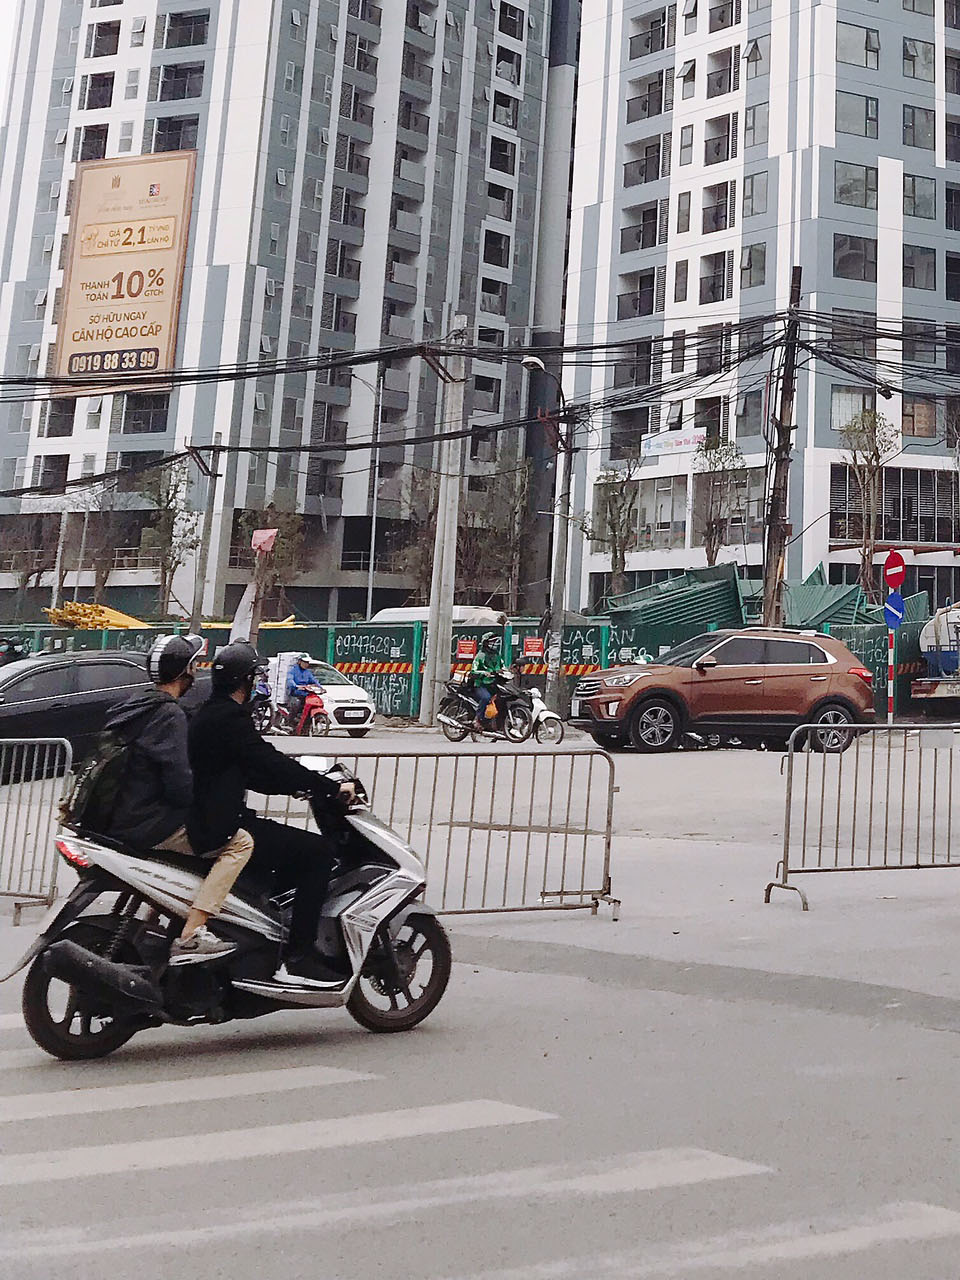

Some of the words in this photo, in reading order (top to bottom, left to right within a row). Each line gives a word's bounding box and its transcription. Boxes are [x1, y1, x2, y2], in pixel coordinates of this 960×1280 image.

[122, 226, 146, 247] 2,1
[80, 281, 110, 291] THANH
[85, 290, 108, 302] TOÁN
[124, 311, 148, 322] NGAY
[115, 326, 138, 338] CAO
[140, 320, 162, 336] CẤP
[72, 354, 101, 372] 0919
[104, 353, 120, 370] 88
[122, 352, 136, 368] 33
[140, 351, 156, 368] 99
